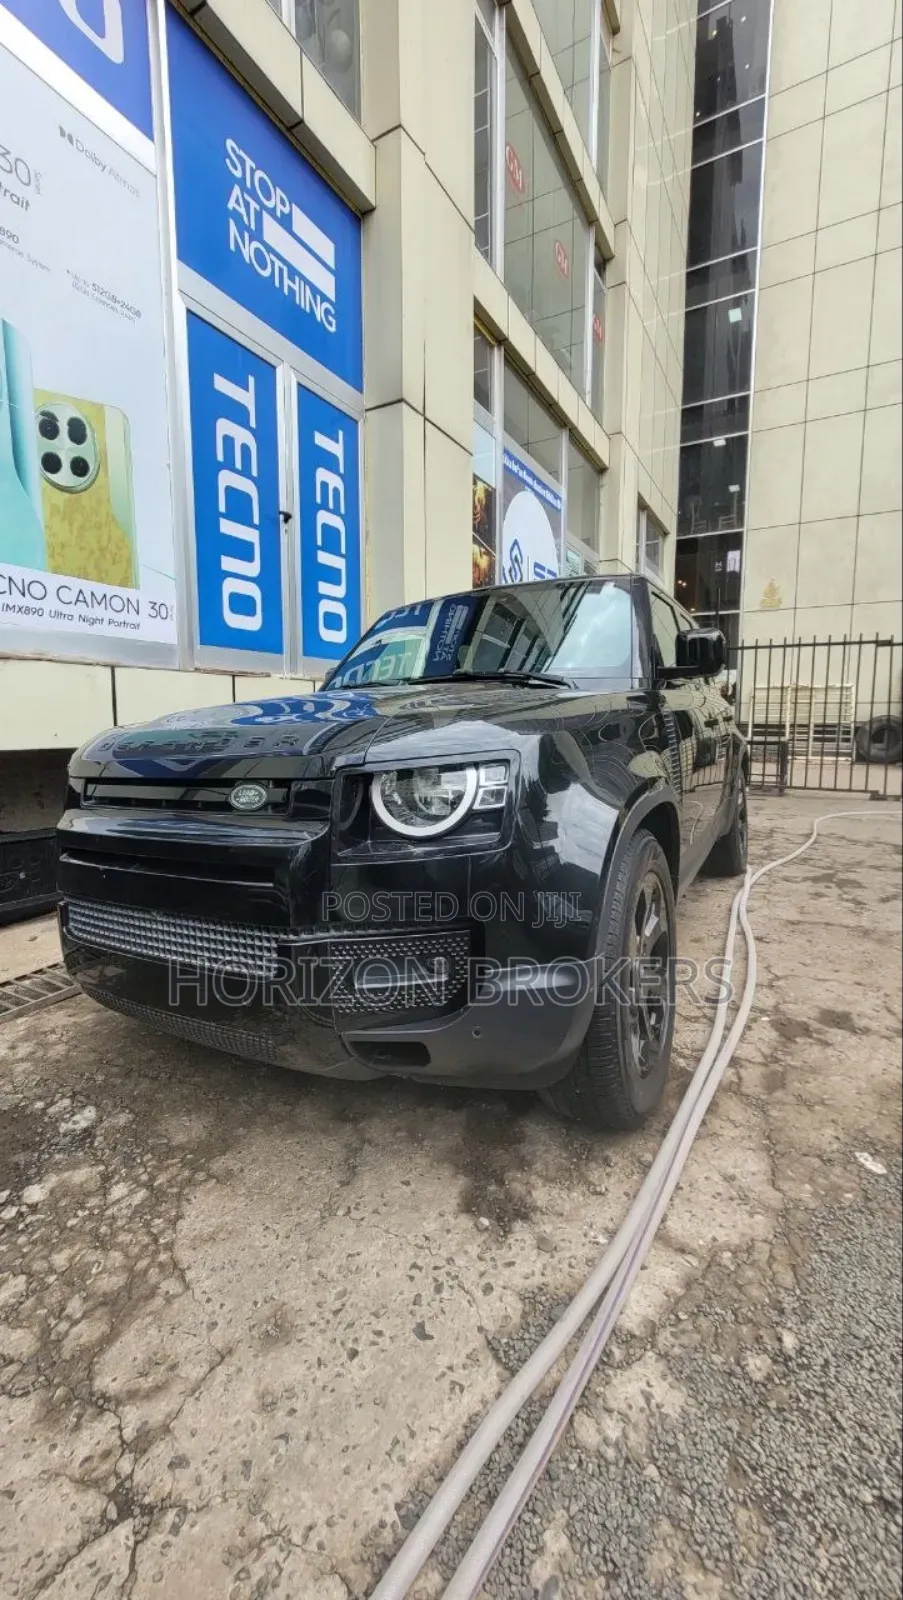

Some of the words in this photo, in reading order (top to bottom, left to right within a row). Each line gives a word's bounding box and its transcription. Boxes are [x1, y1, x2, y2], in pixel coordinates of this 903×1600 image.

[76, 138, 106, 172] Dolby
[225, 138, 290, 218] STOP
[227, 184, 260, 232] AT
[229, 218, 337, 333] NOTHING
[213, 372, 263, 632] TECNO
[314, 429, 347, 644] TECNO
[1, 602, 45, 617] IMX890
[49, 610, 75, 621] Ultra
[78, 614, 105, 626] Night
[108, 618, 141, 631] Portrait
[56, 585, 140, 616] CAMON
[148, 601, 169, 620] 30
